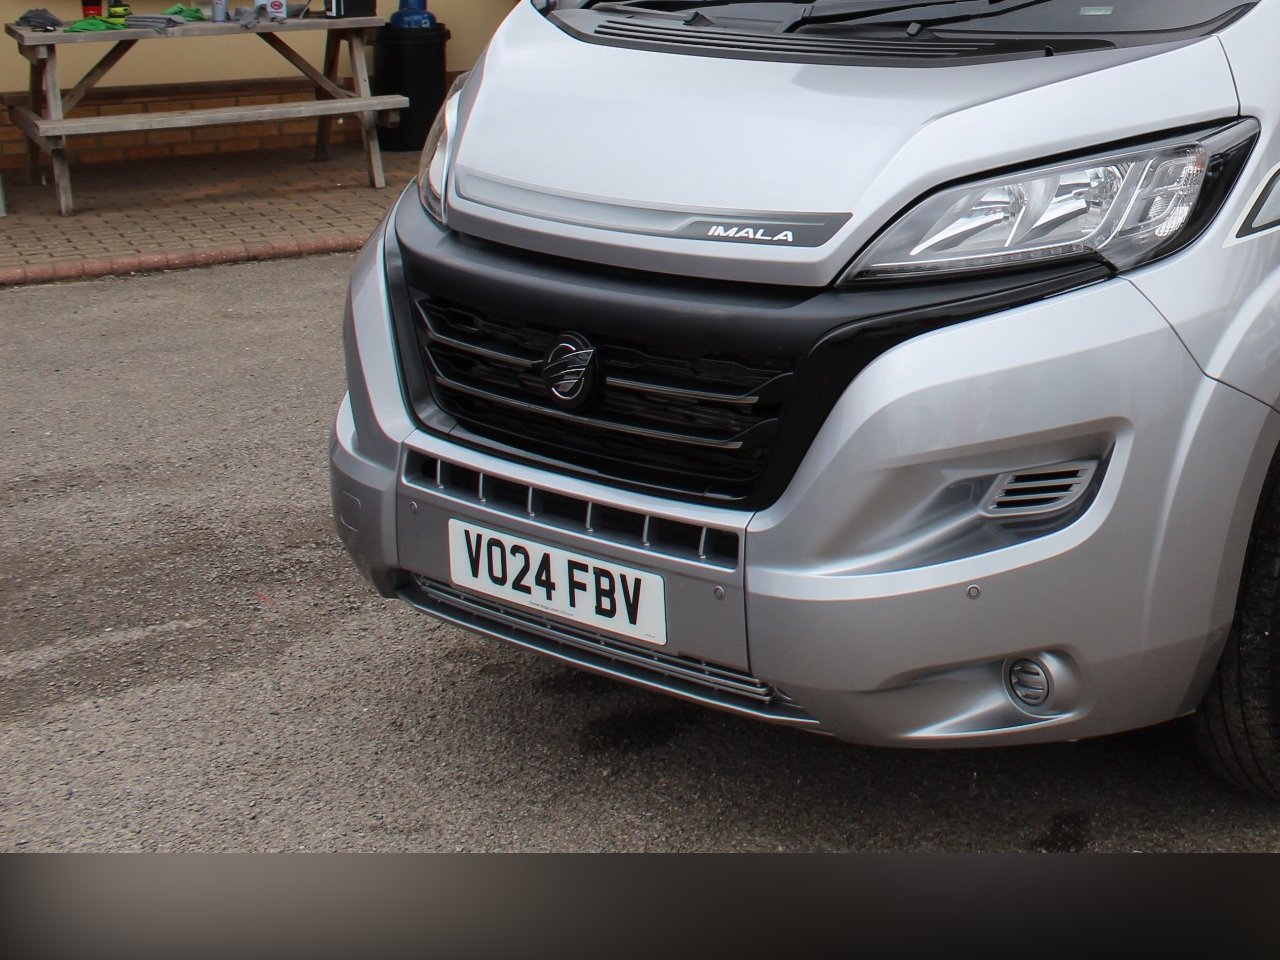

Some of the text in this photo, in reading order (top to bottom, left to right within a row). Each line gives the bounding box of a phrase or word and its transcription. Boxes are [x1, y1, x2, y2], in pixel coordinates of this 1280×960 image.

[707, 225, 794, 242] IMALA
[464, 529, 642, 625] VO24 FBV
